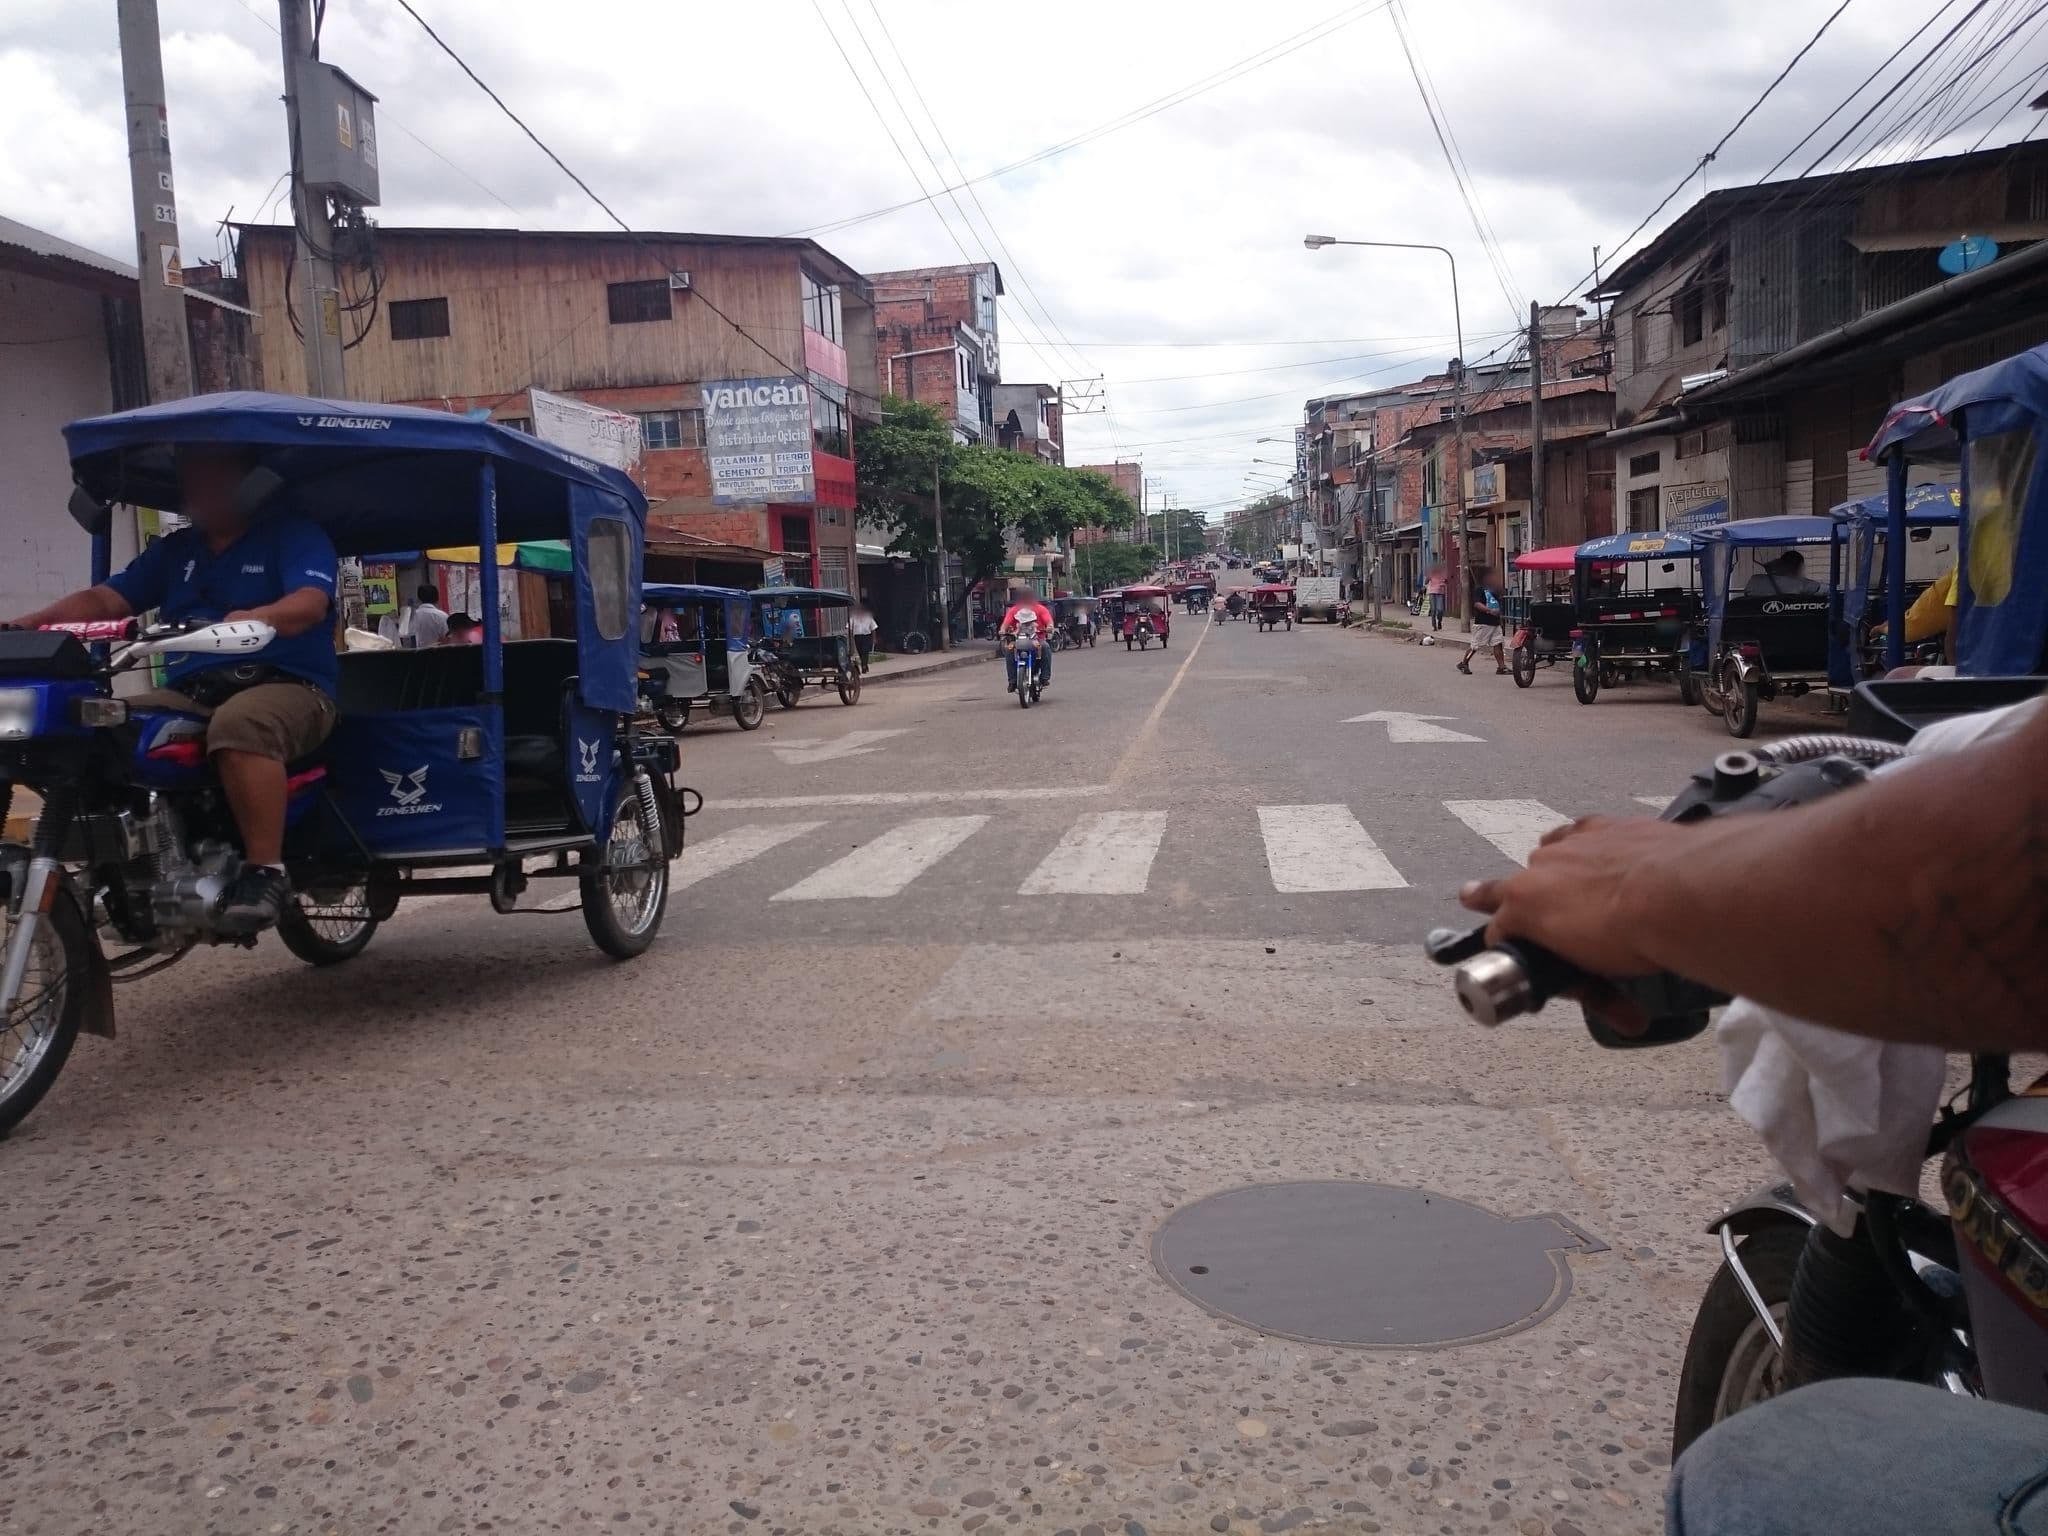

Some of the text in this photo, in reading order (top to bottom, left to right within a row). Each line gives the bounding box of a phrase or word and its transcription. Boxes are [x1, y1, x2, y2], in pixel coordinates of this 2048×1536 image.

[316, 416, 392, 430] ZONGSHEN
[719, 431, 776, 447] Distribuidor
[714, 455, 764, 466] CALAMINA
[776, 452, 810, 462] FIERRO
[1296, 432, 1307, 482] DENTAL
[718, 467, 765, 478] CEMENTO
[779, 464, 812, 474] TRIPLAY
[575, 774, 601, 783] ZONGSHEN
[375, 803, 443, 817] ZONGSHEN
